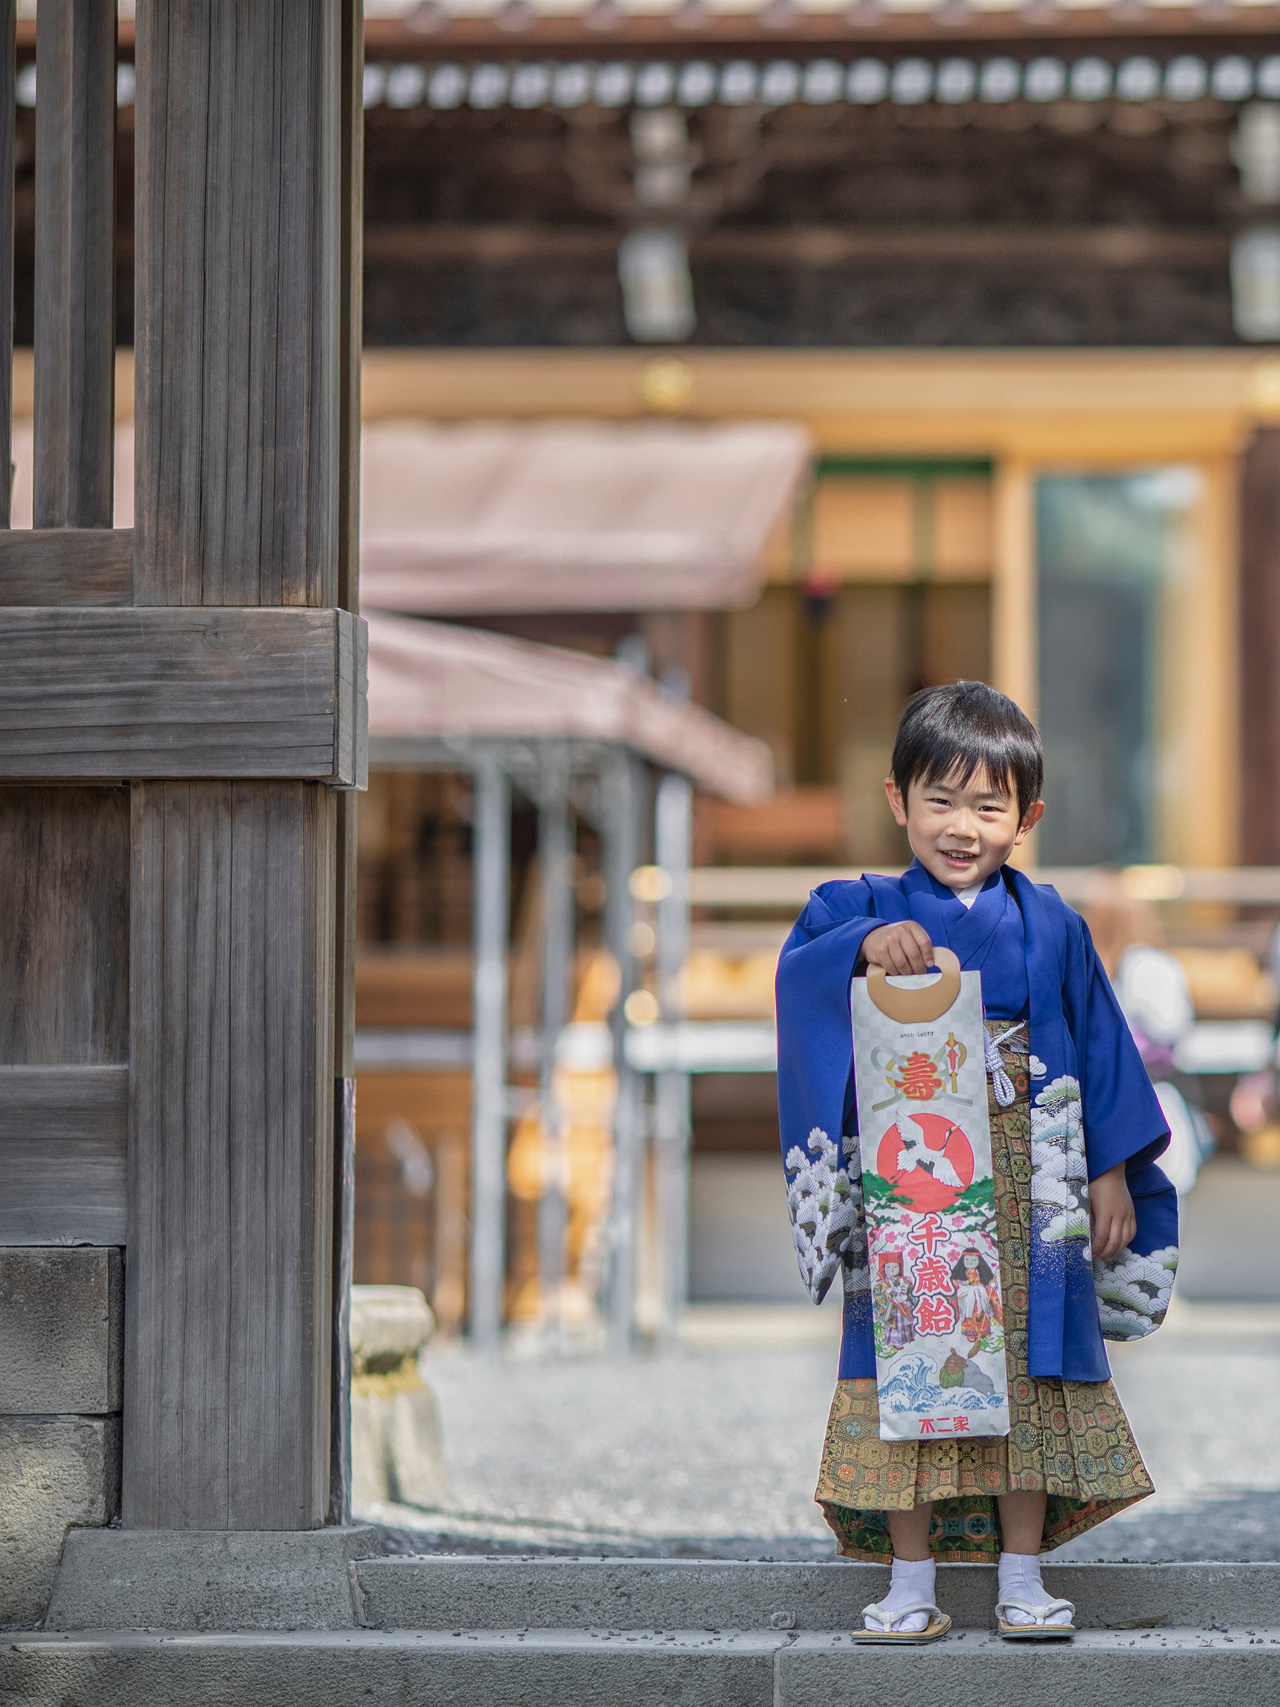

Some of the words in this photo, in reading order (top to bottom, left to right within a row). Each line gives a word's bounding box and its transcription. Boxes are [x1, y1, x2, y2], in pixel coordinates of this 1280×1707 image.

[909, 1214, 953, 1334] 千歳飴
[918, 1415, 970, 1434] 不二家
